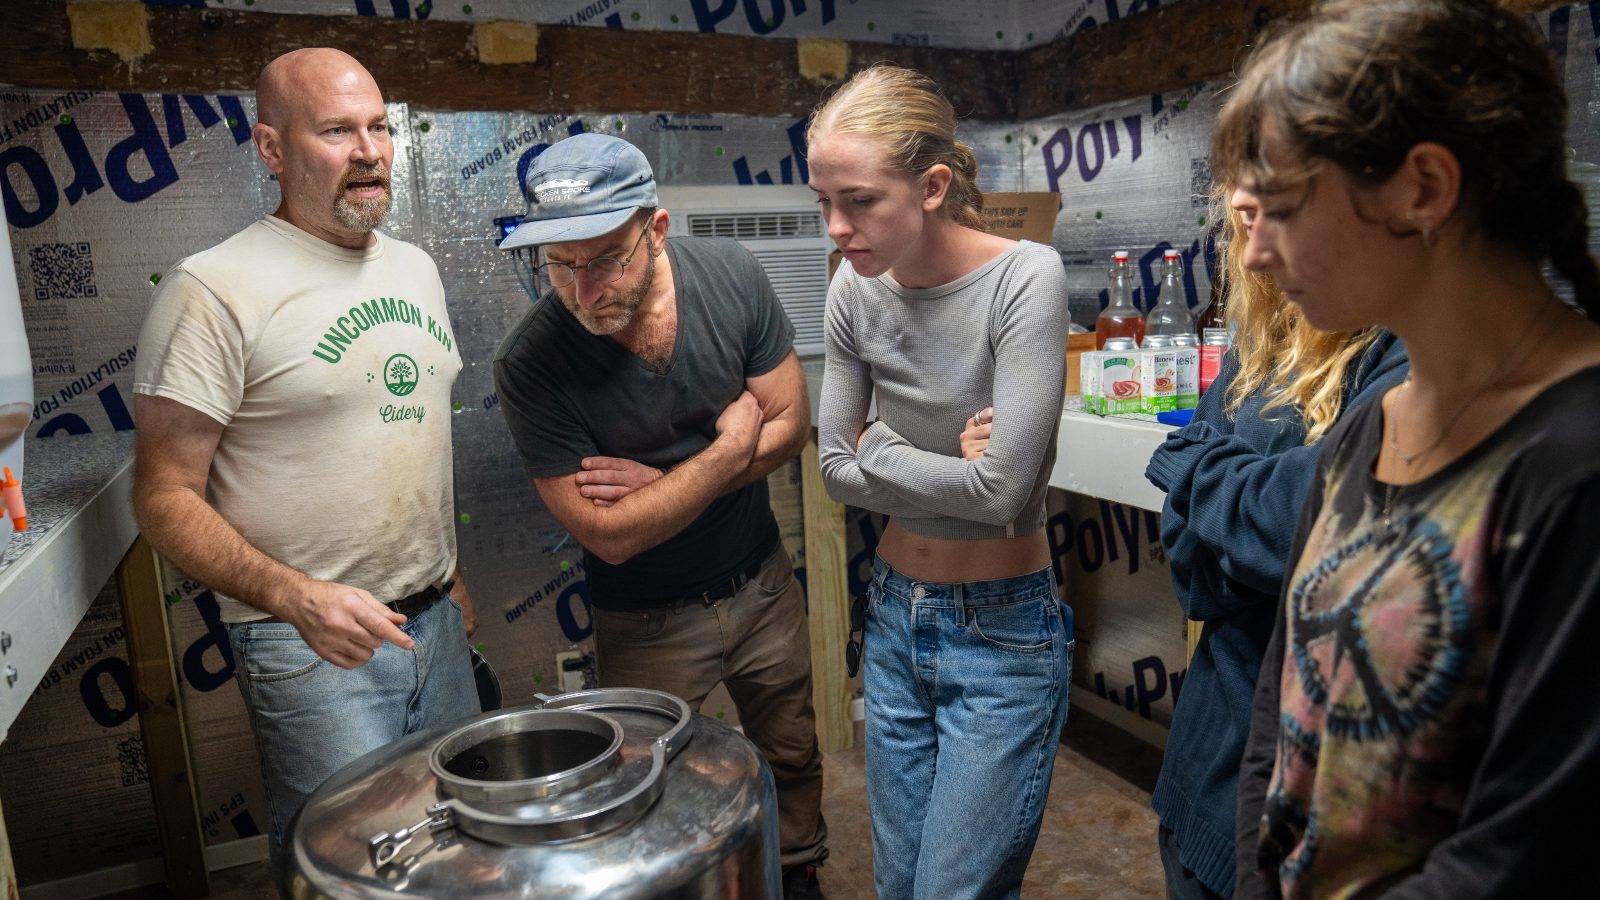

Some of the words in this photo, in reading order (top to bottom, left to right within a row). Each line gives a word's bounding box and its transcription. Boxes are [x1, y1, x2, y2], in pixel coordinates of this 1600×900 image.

[461, 147, 502, 180] BOARD
[312, 297, 422, 364] UNCOMMON
[30, 393, 59, 422] FOA
[379, 404, 426, 424] Cidery
[505, 590, 543, 623] BOARD
[62, 641, 103, 675] FOAM
[221, 793, 245, 817] EPS
